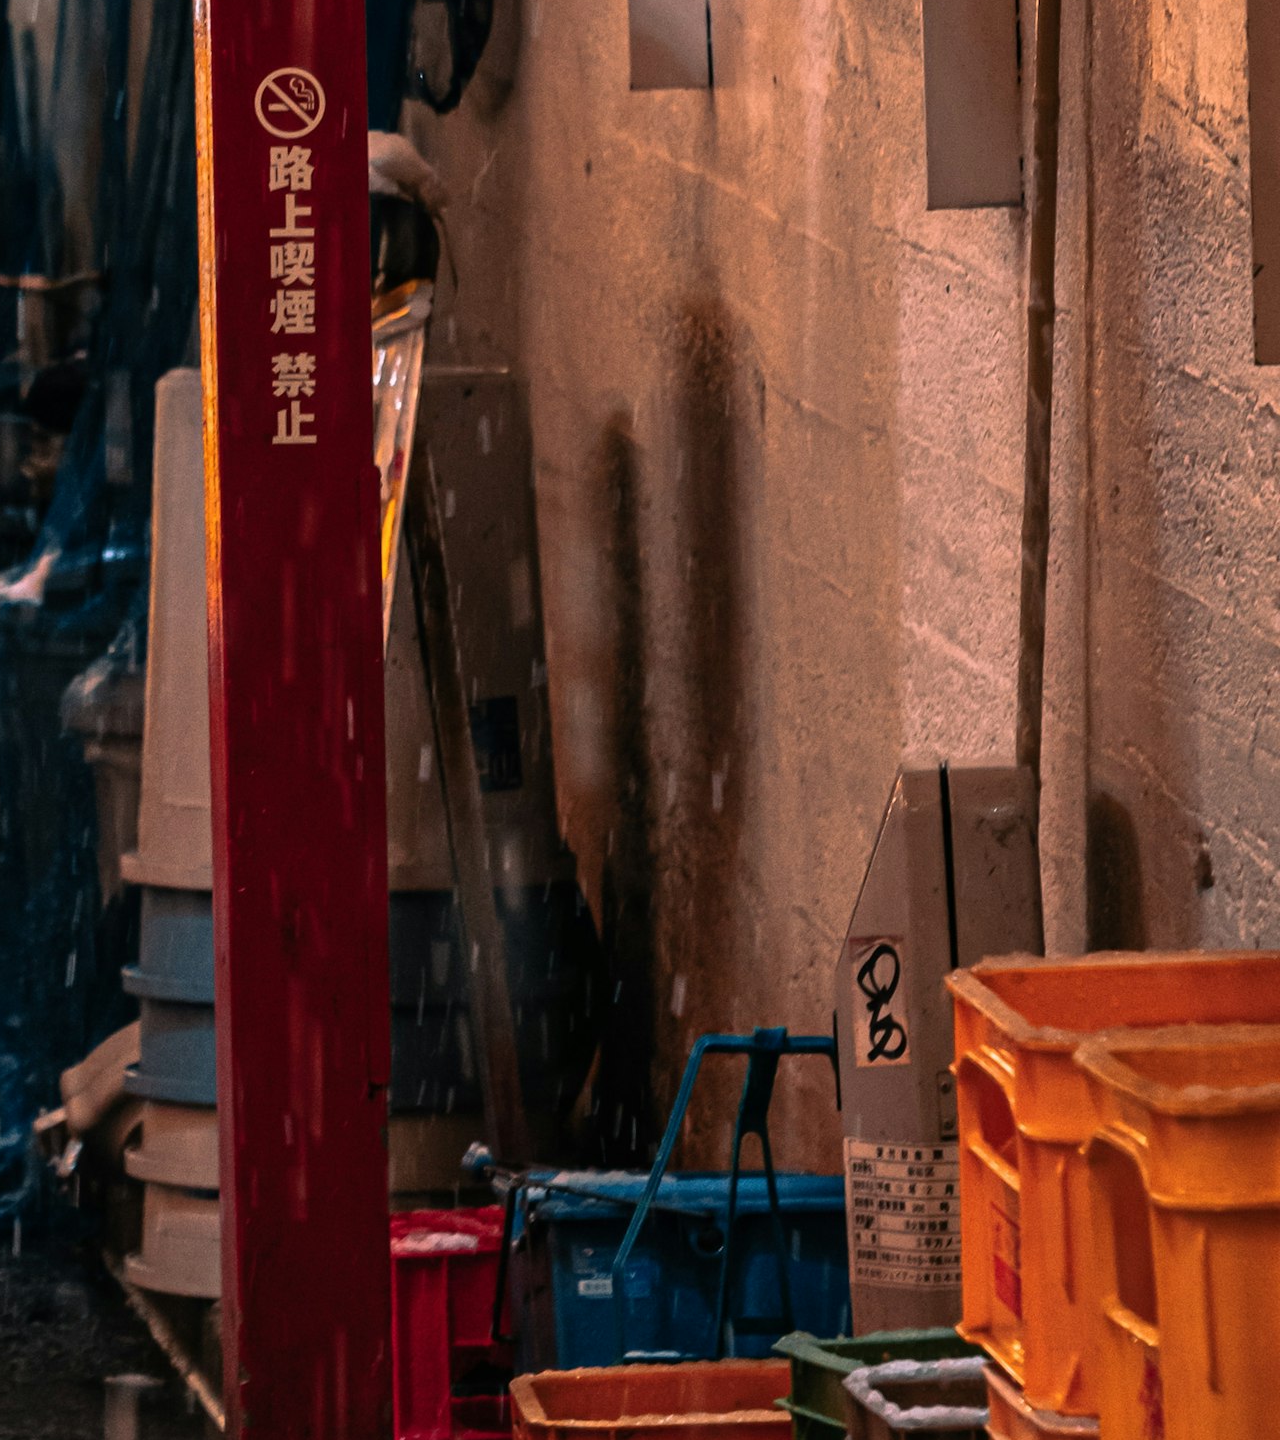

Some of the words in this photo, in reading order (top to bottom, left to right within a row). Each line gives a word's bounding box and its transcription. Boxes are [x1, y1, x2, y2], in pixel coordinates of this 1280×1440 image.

[268, 145, 318, 447] 路上喫煙禁止
